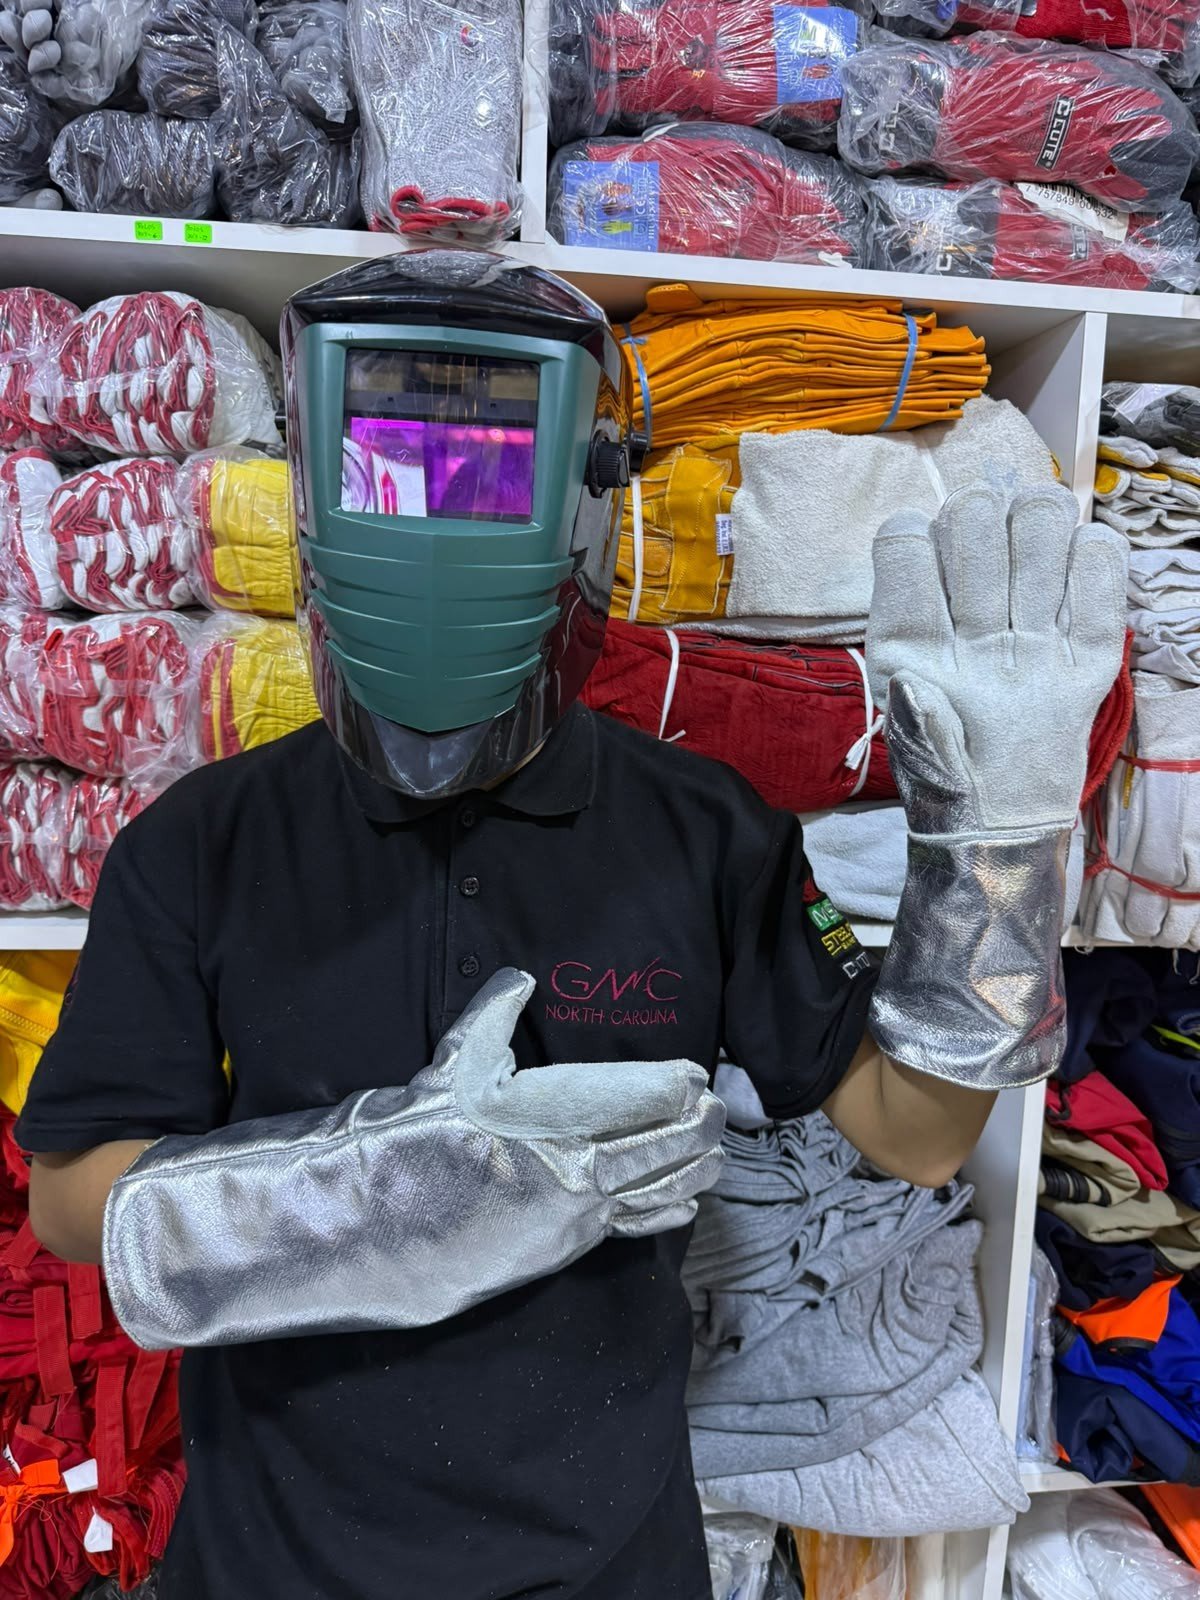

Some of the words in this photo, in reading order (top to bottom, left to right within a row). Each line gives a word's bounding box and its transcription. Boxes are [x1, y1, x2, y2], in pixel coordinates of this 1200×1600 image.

[1042, 99, 1071, 161] CLUTE
[1038, 186, 1075, 207] 757849
[545, 1004, 604, 1024] NORTH
[610, 1009, 678, 1025] CAROLINA
